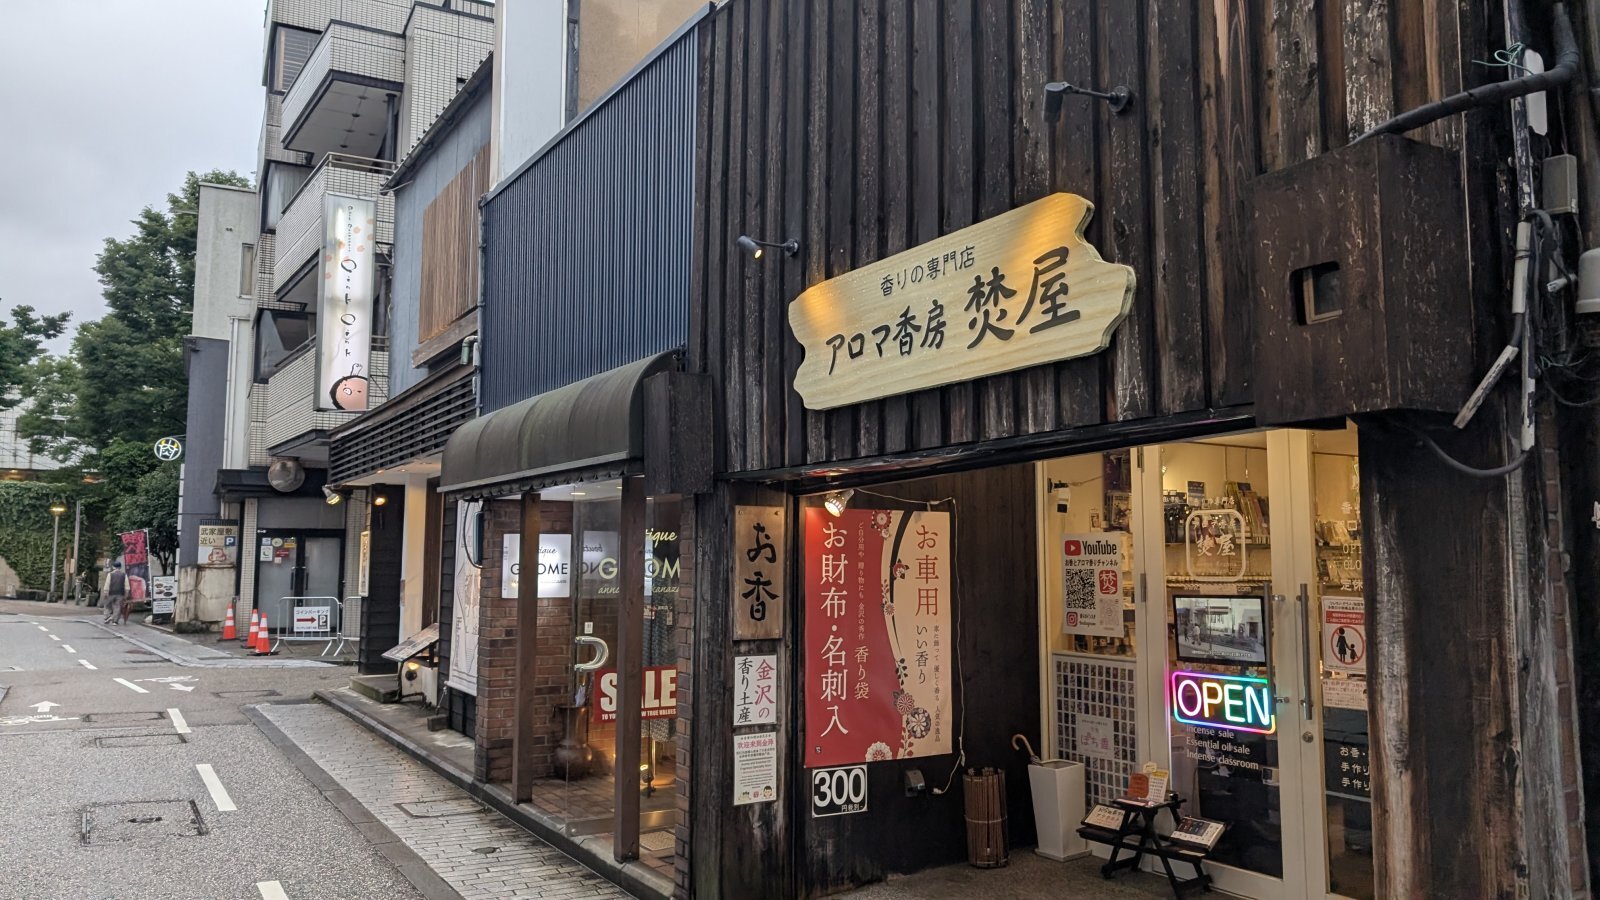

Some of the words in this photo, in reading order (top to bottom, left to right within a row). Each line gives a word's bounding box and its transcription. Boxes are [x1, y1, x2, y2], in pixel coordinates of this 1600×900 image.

[880, 246, 976, 296] 香りの専門店
[826, 299, 947, 376] アロマ香房
[964, 246, 1081, 351] 焚屋
[200, 527, 233, 536] 武家屋敷
[200, 536, 216, 545] 近い
[226, 537, 234, 545] P
[1082, 539, 1118, 556] YouTube
[510, 562, 568, 575] GOME
[741, 522, 780, 622] お香
[915, 524, 940, 617] お車用
[1341, 580, 1363, 592] 定休
[820, 521, 849, 738] お財布・名刺入
[854, 645, 870, 700] 香り袋
[916, 625, 929, 685] いい香り
[600, 669, 677, 712] SLE
[736, 657, 754, 724] 香り土産
[754, 658, 776, 720] 金沢の
[1177, 679, 1271, 727] OPEN
[1186, 724, 1215, 736] Incense
[1218, 729, 1235, 739] sale
[1186, 736, 1220, 750] Essential
[1233, 745, 1251, 755] sale
[1186, 748, 1216, 762] Incense
[1218, 755, 1259, 770] classroom
[814, 768, 865, 807] 300
